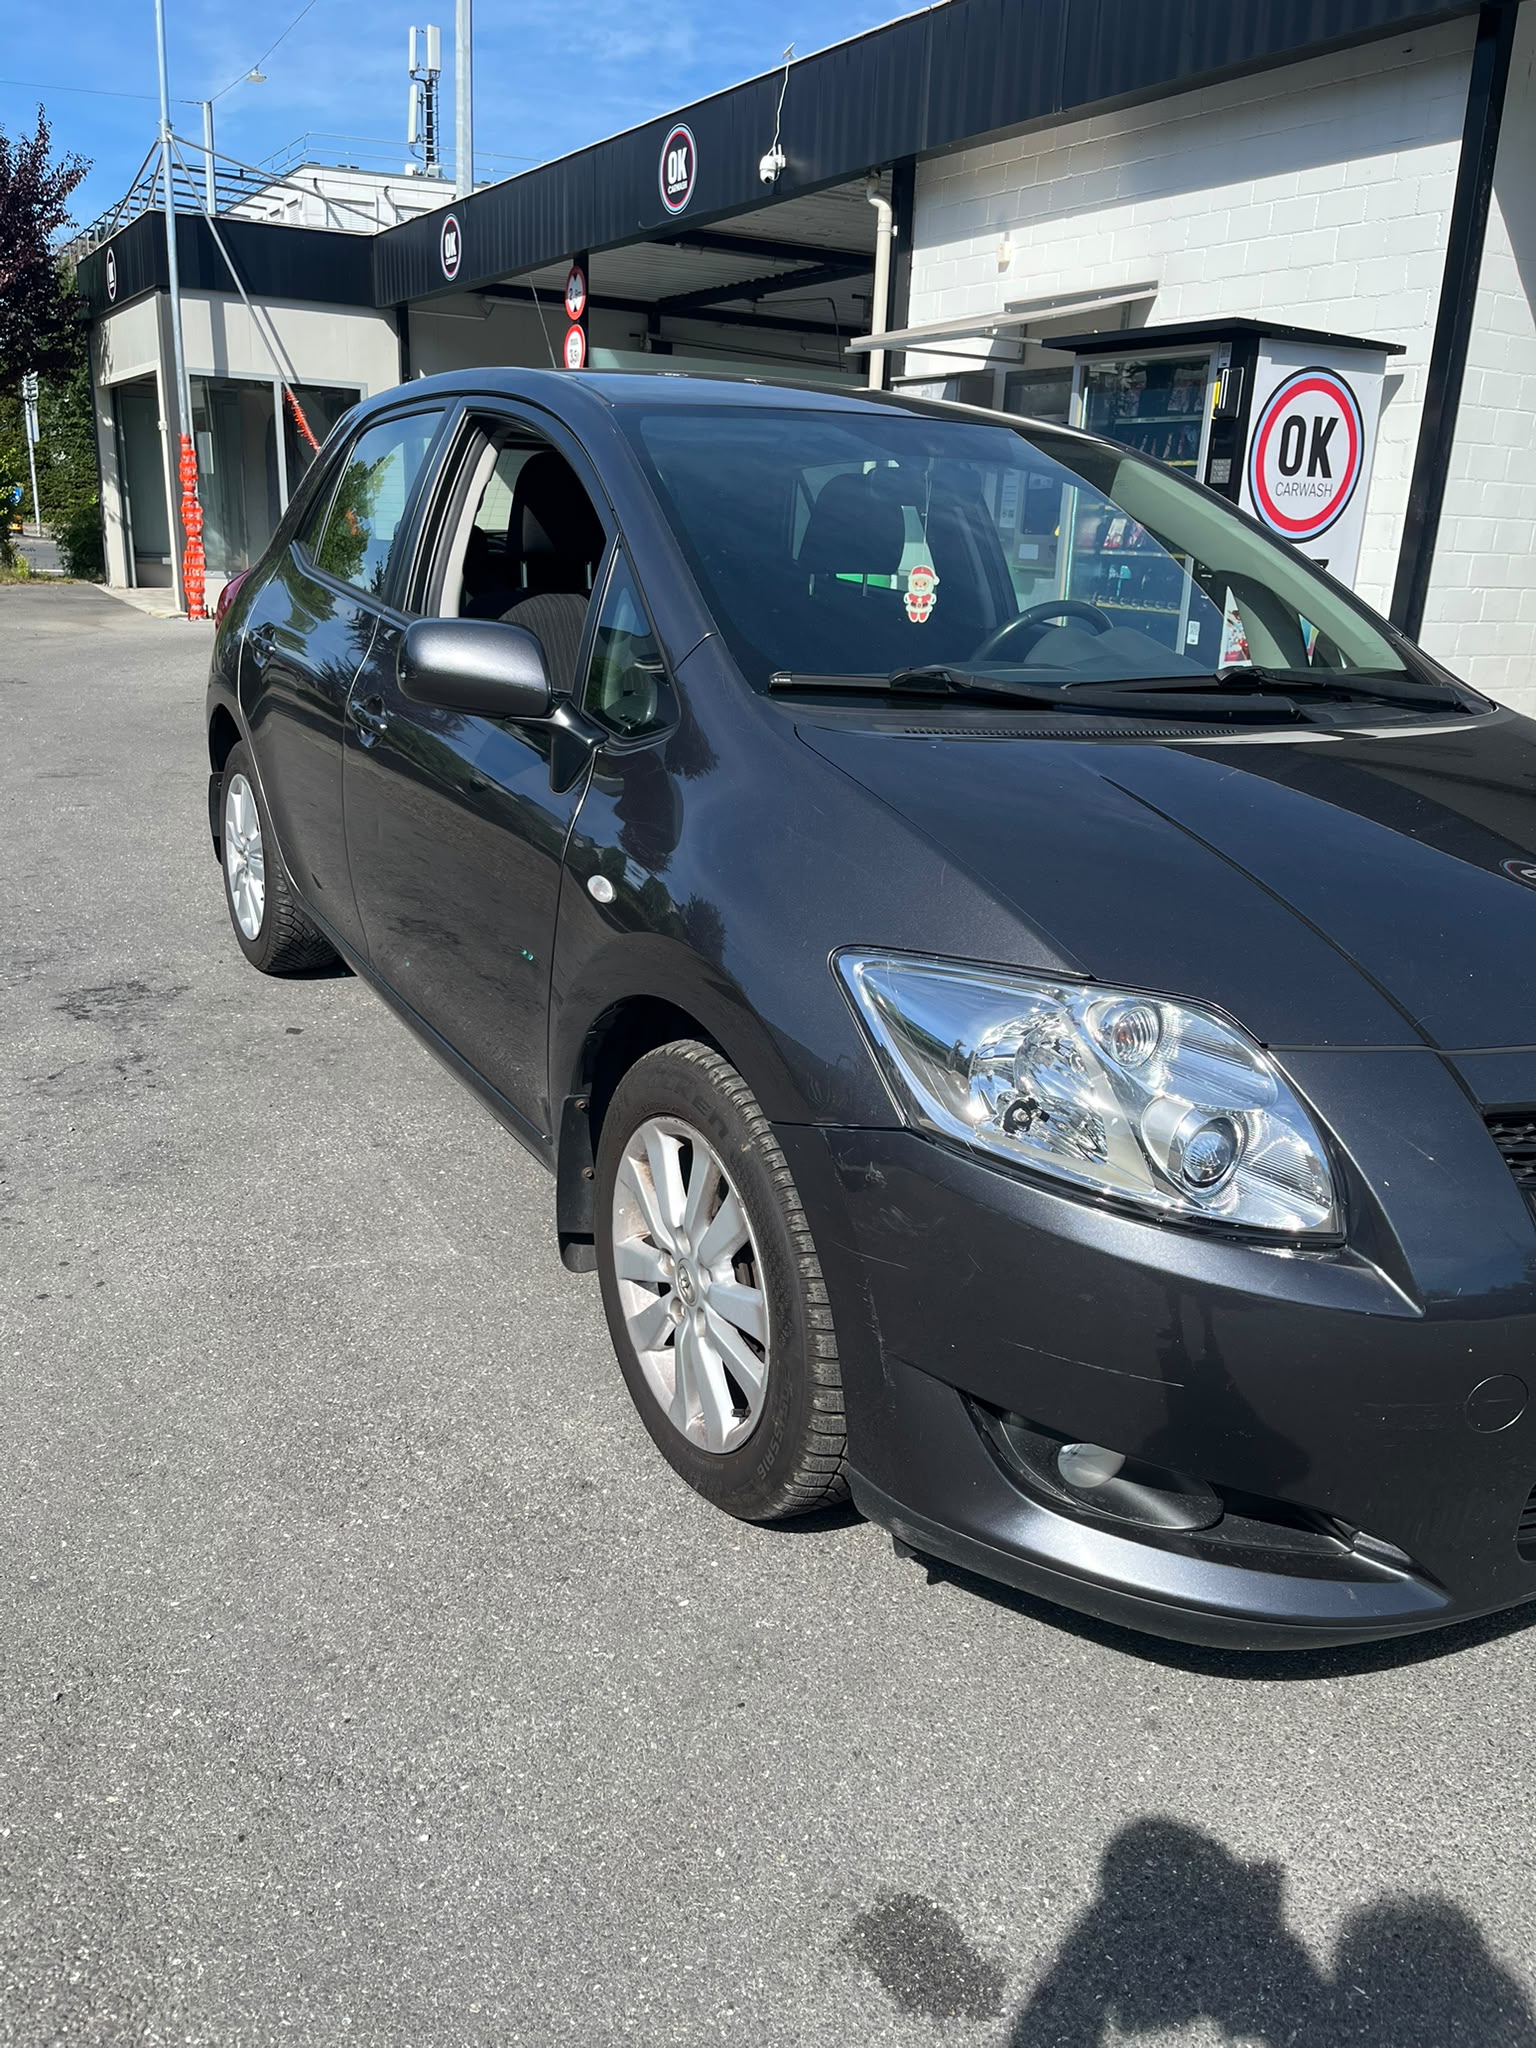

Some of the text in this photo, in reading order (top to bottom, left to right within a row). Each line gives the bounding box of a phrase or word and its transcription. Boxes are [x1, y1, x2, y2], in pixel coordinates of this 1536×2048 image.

[667, 147, 687, 184] OK
[445, 231, 457, 258] OK
[1278, 414, 1339, 478] OK
[1275, 481, 1333, 498] CARWASH
